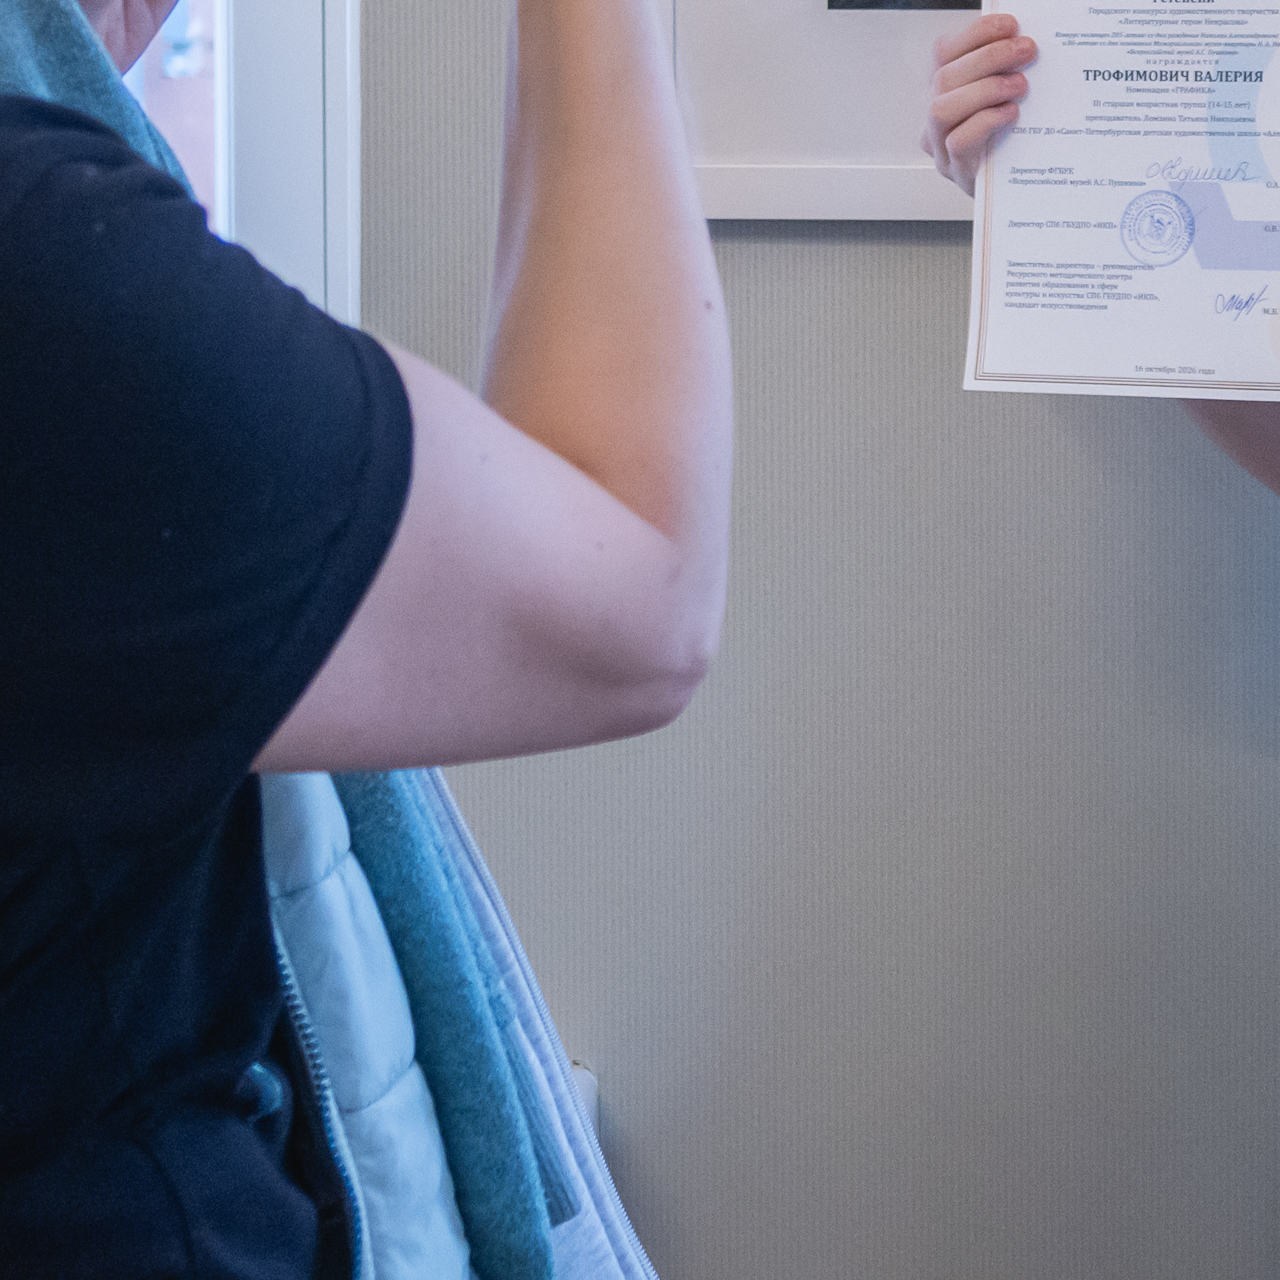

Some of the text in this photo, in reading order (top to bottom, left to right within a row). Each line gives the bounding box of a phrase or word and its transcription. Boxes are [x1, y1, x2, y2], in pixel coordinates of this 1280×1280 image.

[1089, 7, 1131, 15] Городского
[1083, 69, 1263, 82] ТРОФИМОВИЧ ВАЛЕРИЯ
[1126, 86, 1169, 94] Номинация
[1180, 102, 1206, 110] группа
[1208, 101, 1232, 110] (14-15
[1174, 130, 1236, 138] художественная
[1010, 167, 1046, 175] Директор
[1008, 178, 1068, 186] «Всероссийский
[1108, 179, 1146, 187] Пушкина»
[1008, 220, 1044, 229] Директор
[1007, 260, 1054, 268] Заместитель
[1042, 282, 1089, 290] образования
[1097, 282, 1118, 291] сфере
[1145, 365, 1176, 374] октября
